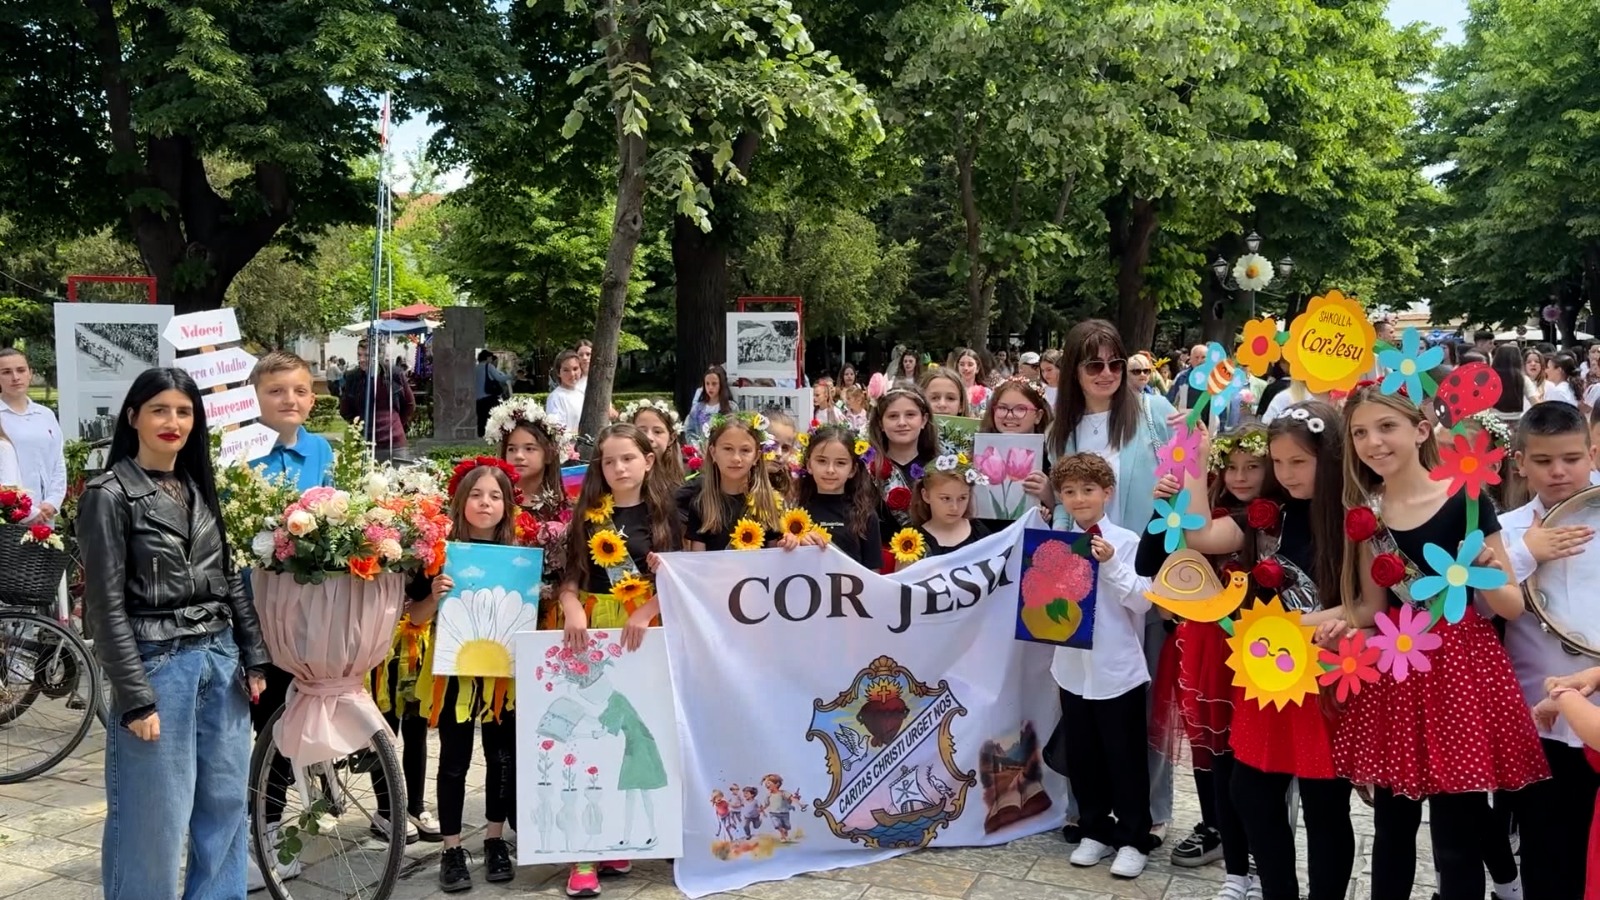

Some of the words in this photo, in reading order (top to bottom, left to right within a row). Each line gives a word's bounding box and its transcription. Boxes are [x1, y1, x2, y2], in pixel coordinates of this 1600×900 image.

[180, 321, 224, 340] Ndocej
[1319, 310, 1353, 328] SHKOLLA
[186, 367, 208, 380] rra
[209, 367, 215, 377] e
[216, 357, 247, 376] Madhe
[728, 572, 874, 625] COR
[887, 545, 1014, 634] JESU
[838, 771, 872, 814] CARITAS
[873, 740, 906, 778] CHRISTI
[906, 712, 933, 748] URGET
[934, 694, 952, 721] NOS
